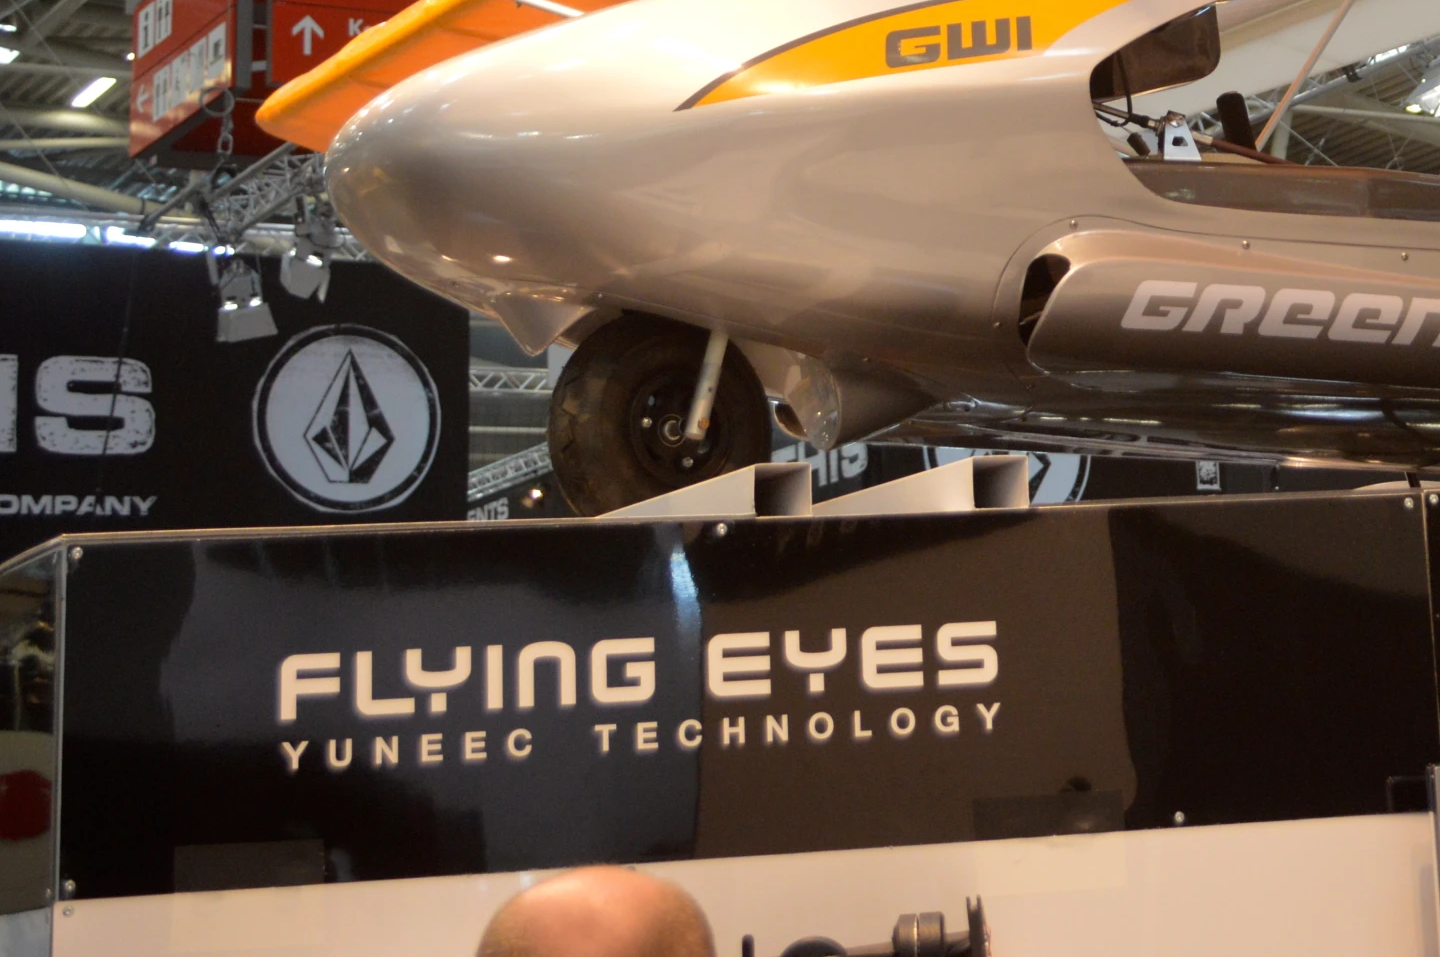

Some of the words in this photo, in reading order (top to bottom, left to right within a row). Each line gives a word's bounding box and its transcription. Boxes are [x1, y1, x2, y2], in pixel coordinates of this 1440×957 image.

[277, 636, 656, 723] FLYING
[707, 620, 999, 698] EYES
[281, 728, 533, 770] YUNEEC
[594, 702, 1001, 753] TECHNOLOGY
